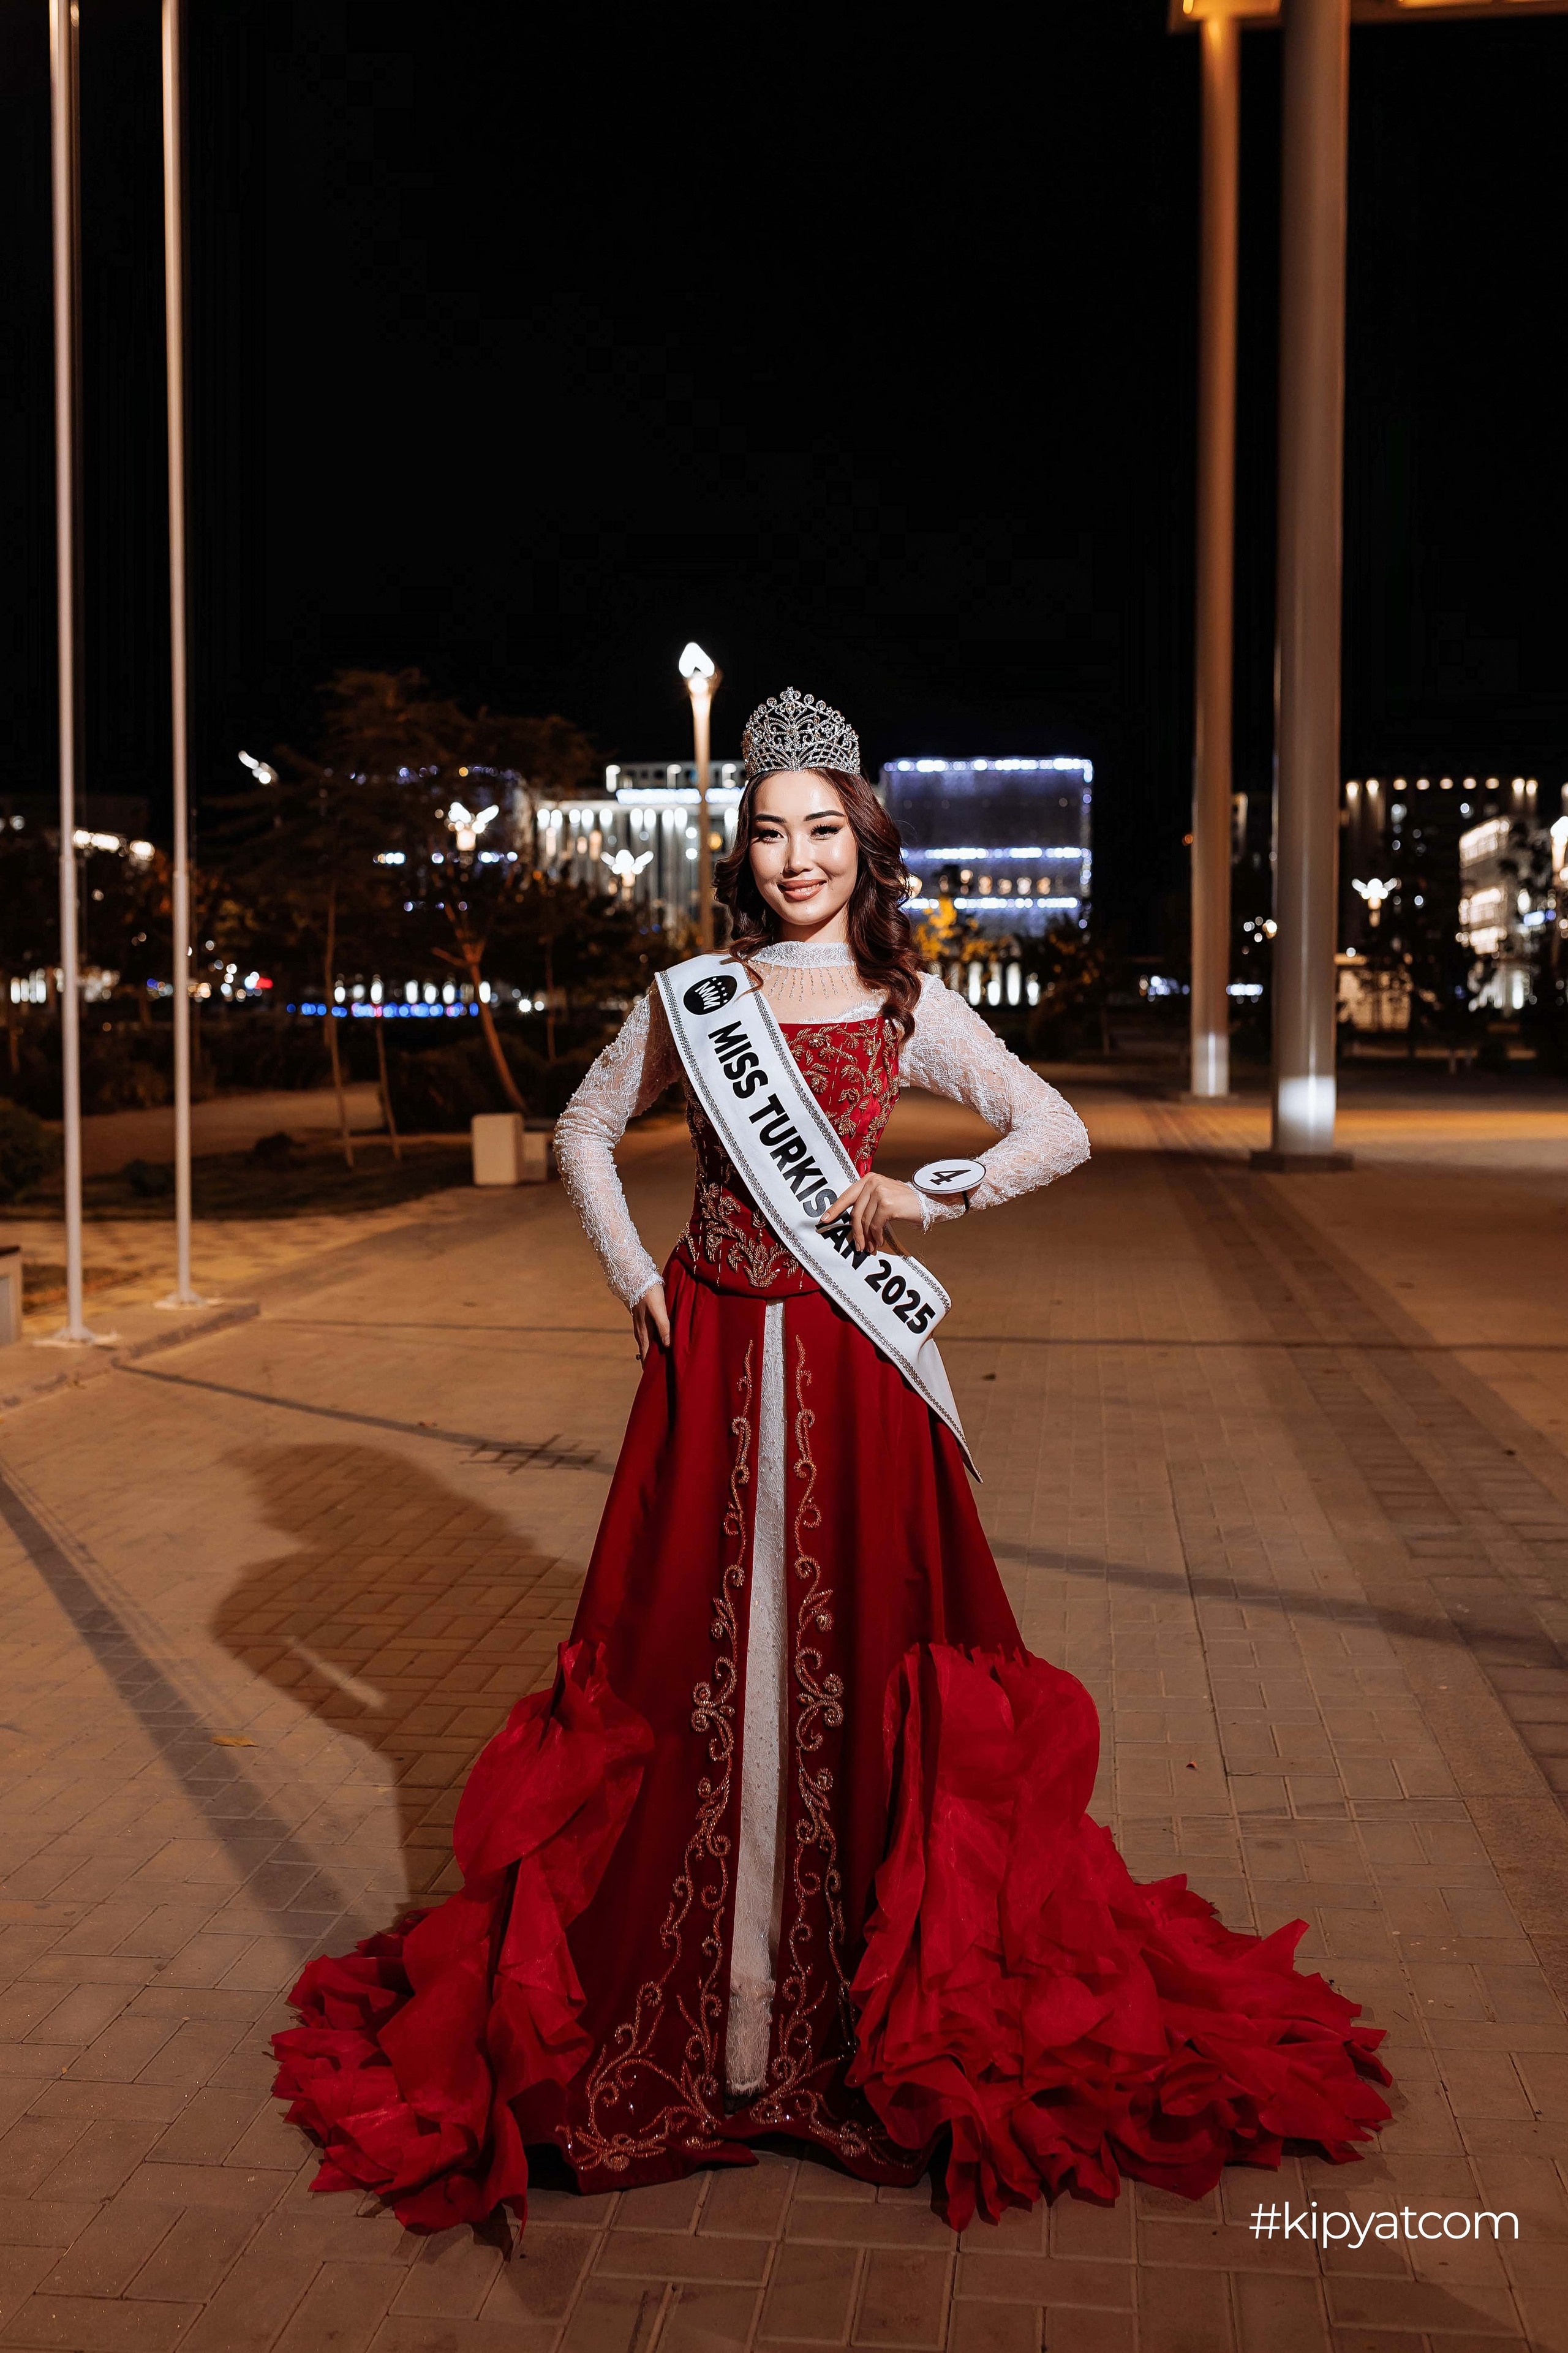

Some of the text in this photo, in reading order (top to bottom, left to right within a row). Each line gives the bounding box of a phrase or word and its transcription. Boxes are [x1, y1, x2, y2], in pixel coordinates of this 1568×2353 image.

[707, 1020, 769, 1099] MISS
[864, 1259, 936, 1334] 2025
[929, 1169, 971, 1186] 4
